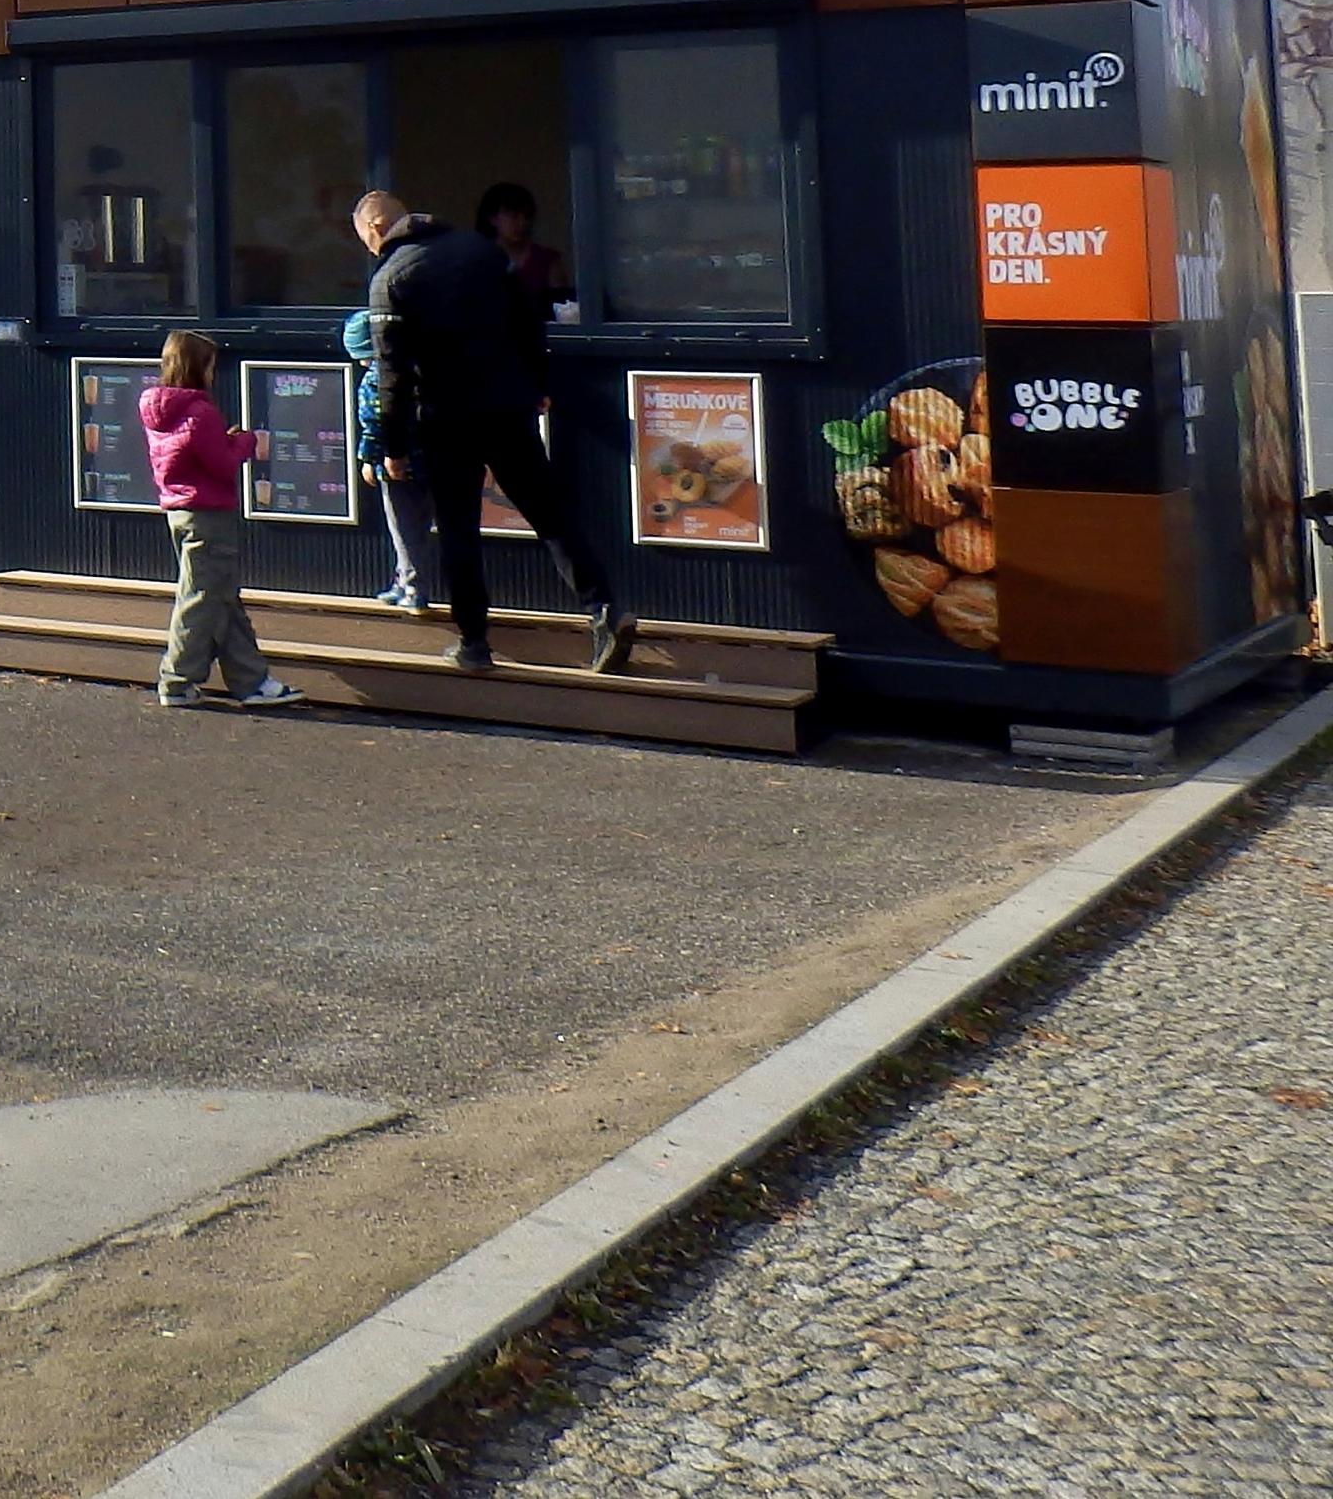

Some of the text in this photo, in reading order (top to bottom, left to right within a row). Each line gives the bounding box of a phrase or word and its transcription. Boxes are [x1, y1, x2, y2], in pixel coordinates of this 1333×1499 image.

[985, 203, 1042, 228] PRO
[986, 226, 1109, 256] KRÁSNÝ
[989, 258, 1052, 284] DEN.
[1014, 379, 1142, 408] BUBBLE
[1030, 403, 1127, 431] ONE
